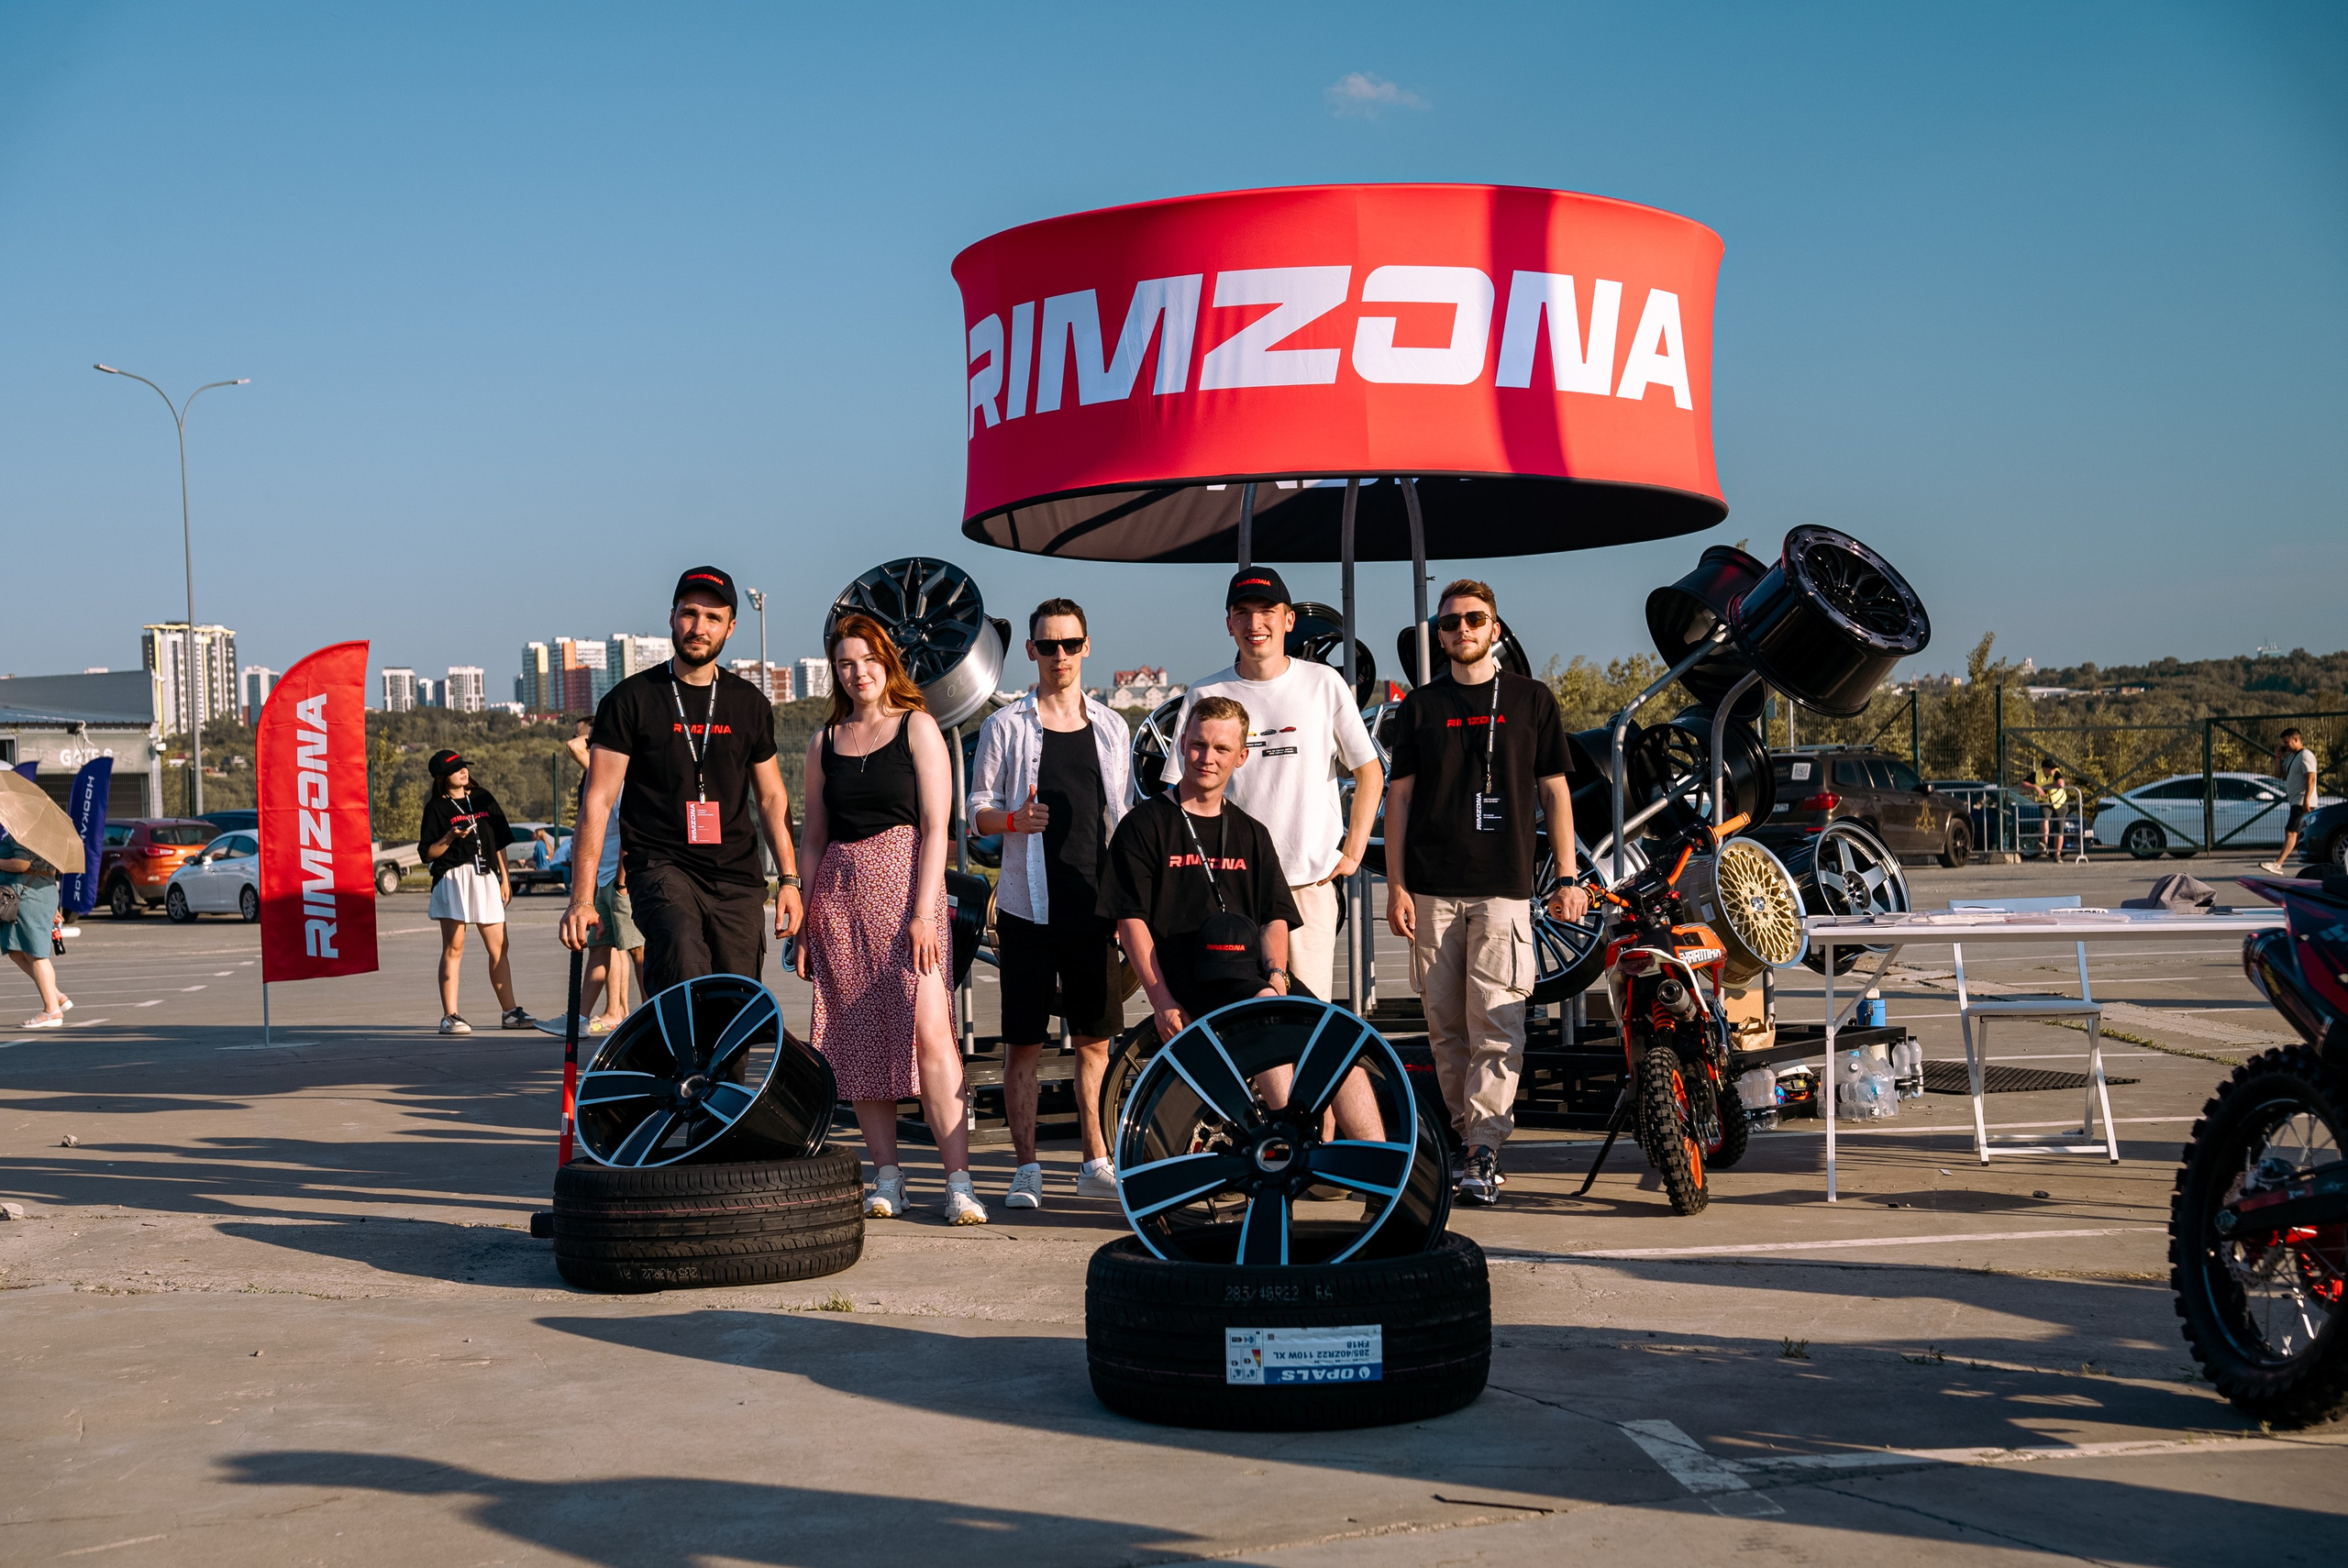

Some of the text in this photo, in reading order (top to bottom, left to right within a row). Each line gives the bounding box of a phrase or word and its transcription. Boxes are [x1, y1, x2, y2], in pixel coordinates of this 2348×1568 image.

[969, 265, 1693, 441] RIMZONA
[673, 723, 732, 734] RMZNA
[296, 692, 339, 959] RIMZONA
[1168, 854, 1247, 870] RIMONA
[1273, 1352, 1285, 1360] XL
[1289, 1351, 1312, 1359] 110W
[1281, 1368, 1354, 1381] OPALS
